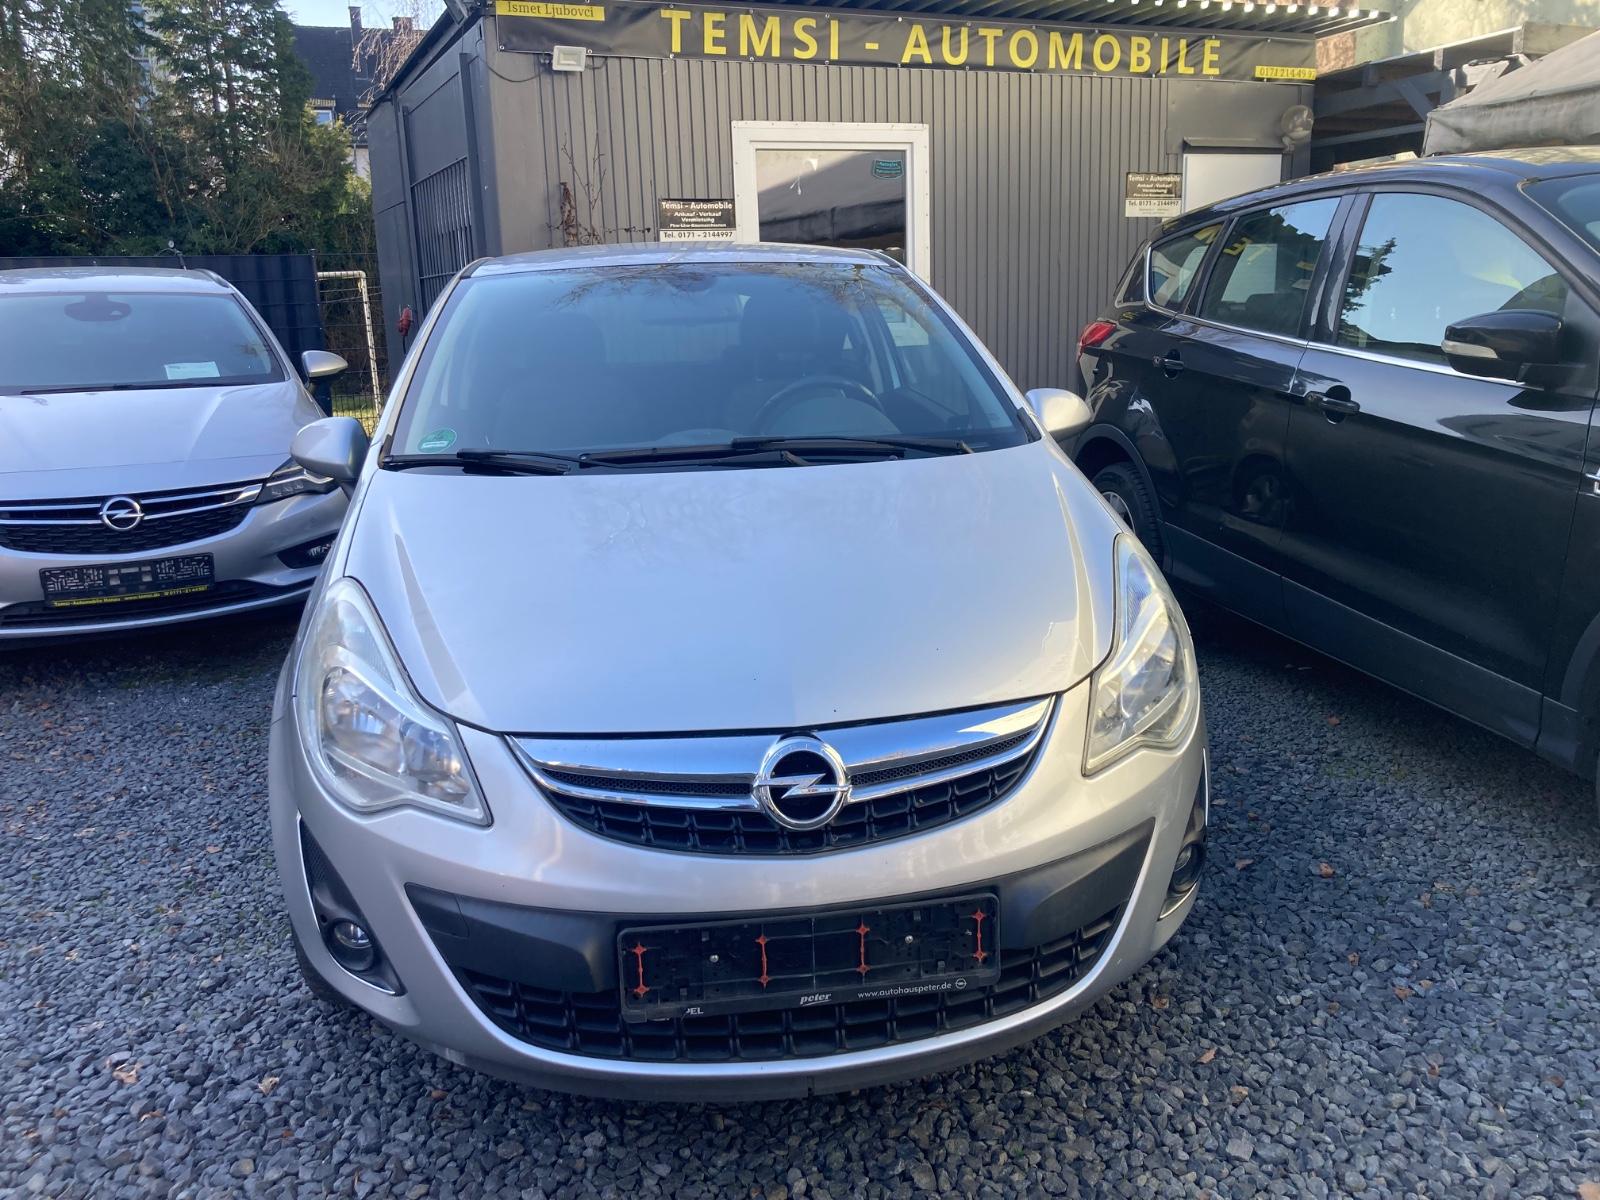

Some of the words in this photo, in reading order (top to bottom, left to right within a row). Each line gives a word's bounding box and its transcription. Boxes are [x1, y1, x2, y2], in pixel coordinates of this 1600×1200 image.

[507, 2, 541, 15] Ismet
[660, 8, 839, 60] TEMSI
[901, 24, 1221, 76] AUTOMOBILE
[661, 201, 683, 210] Temsi
[690, 201, 733, 210] Automobile
[857, 982, 952, 999] www.autohauspeter.de
